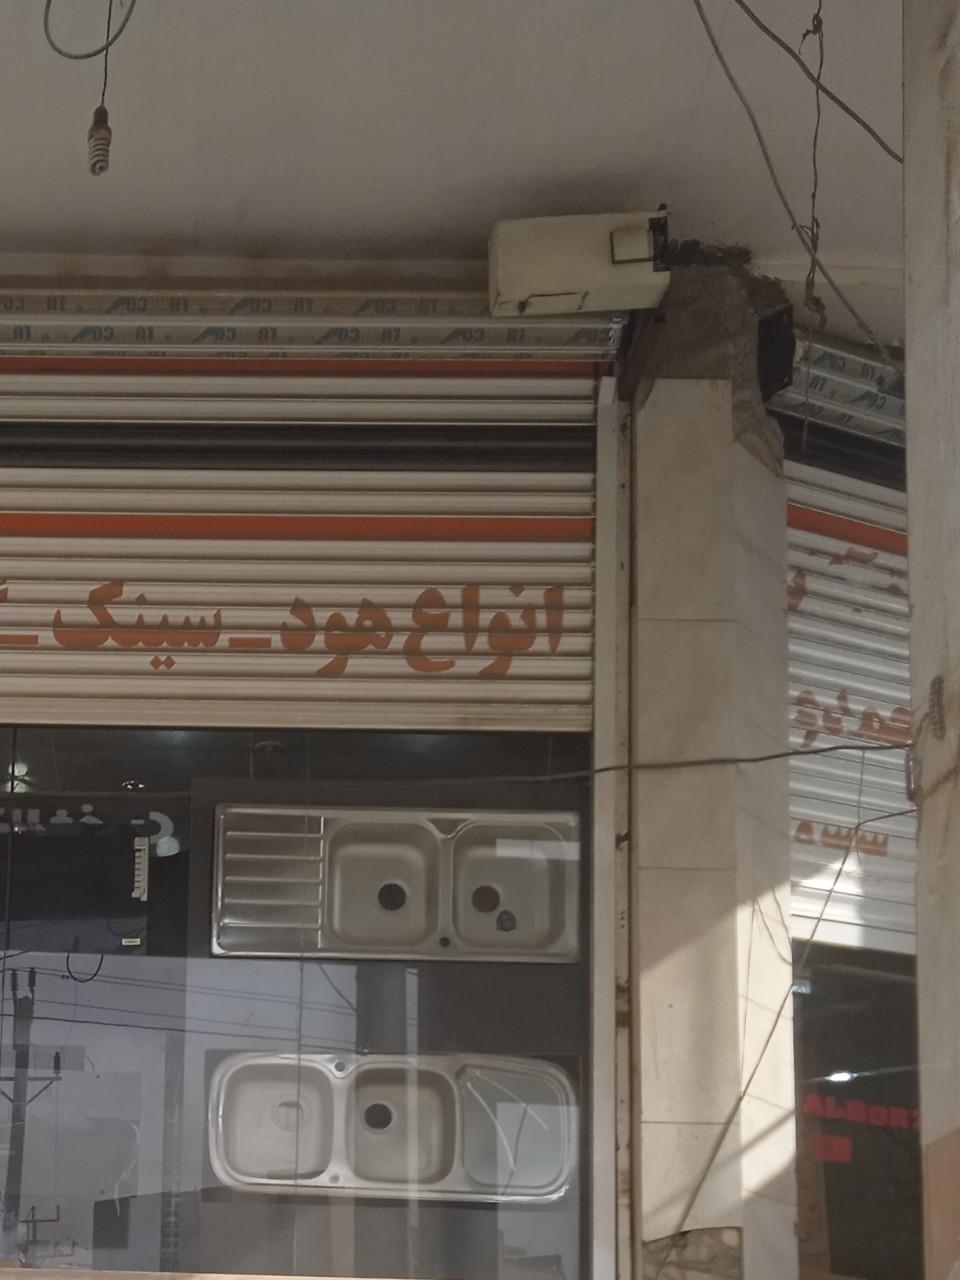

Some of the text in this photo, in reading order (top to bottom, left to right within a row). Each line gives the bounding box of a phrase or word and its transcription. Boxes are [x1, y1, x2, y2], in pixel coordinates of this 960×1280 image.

[52, 581, 222, 671] سینک
[280, 597, 393, 677] هود
[403, 584, 566, 678] انواع
